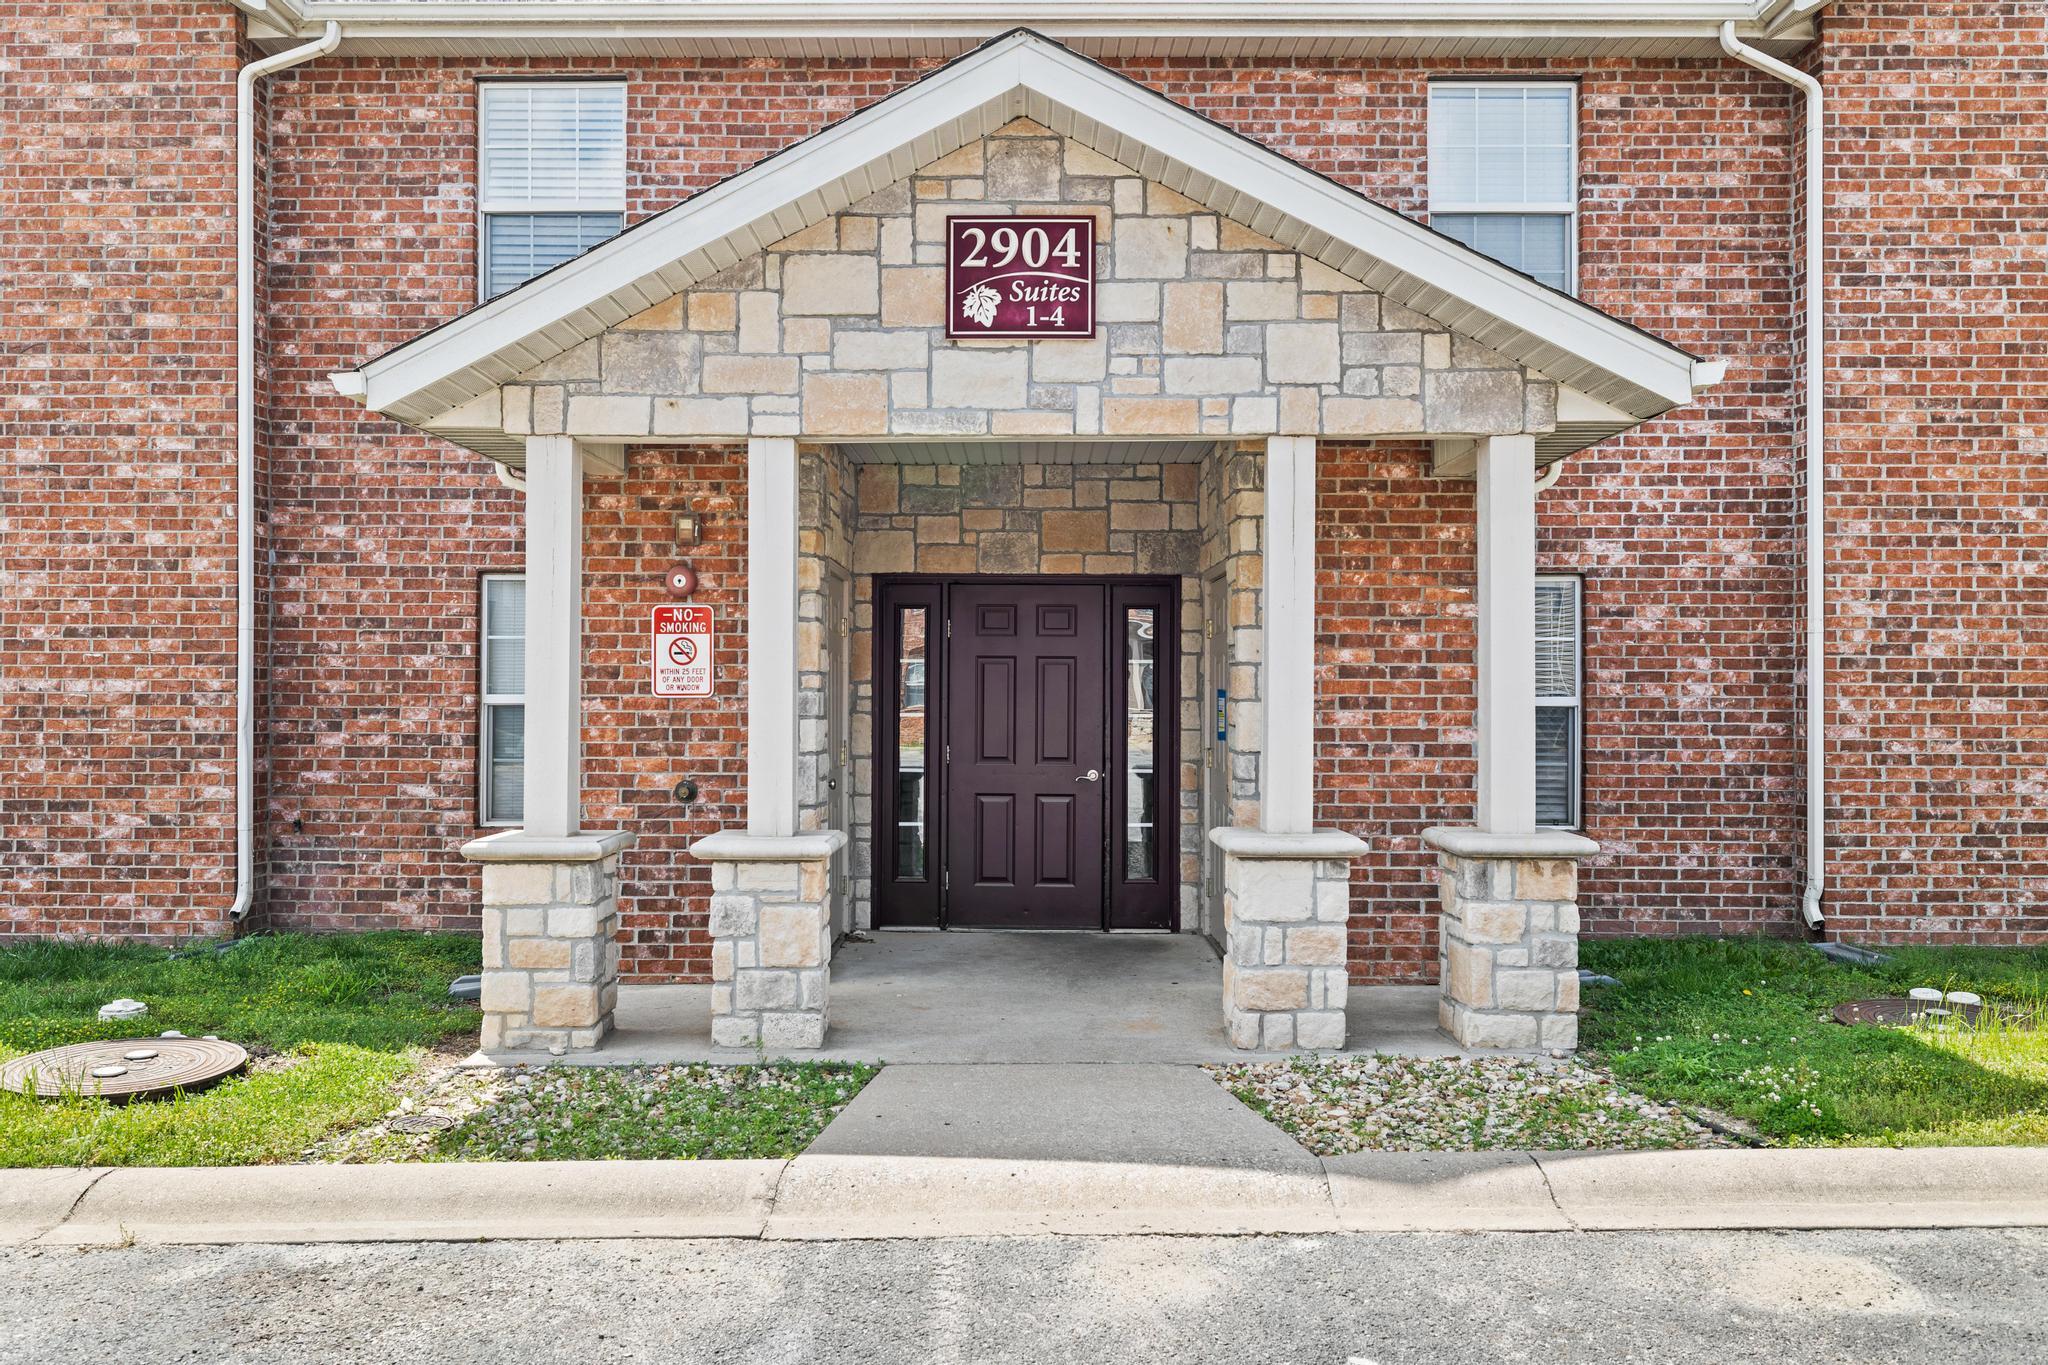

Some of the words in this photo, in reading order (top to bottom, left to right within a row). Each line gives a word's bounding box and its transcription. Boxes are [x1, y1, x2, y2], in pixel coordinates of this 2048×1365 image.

[960, 227, 1081, 268] 2904
[1009, 279, 1081, 302] Suites
[1026, 305, 1065, 327] 1-4
[660, 622, 706, 633] SMOKING
